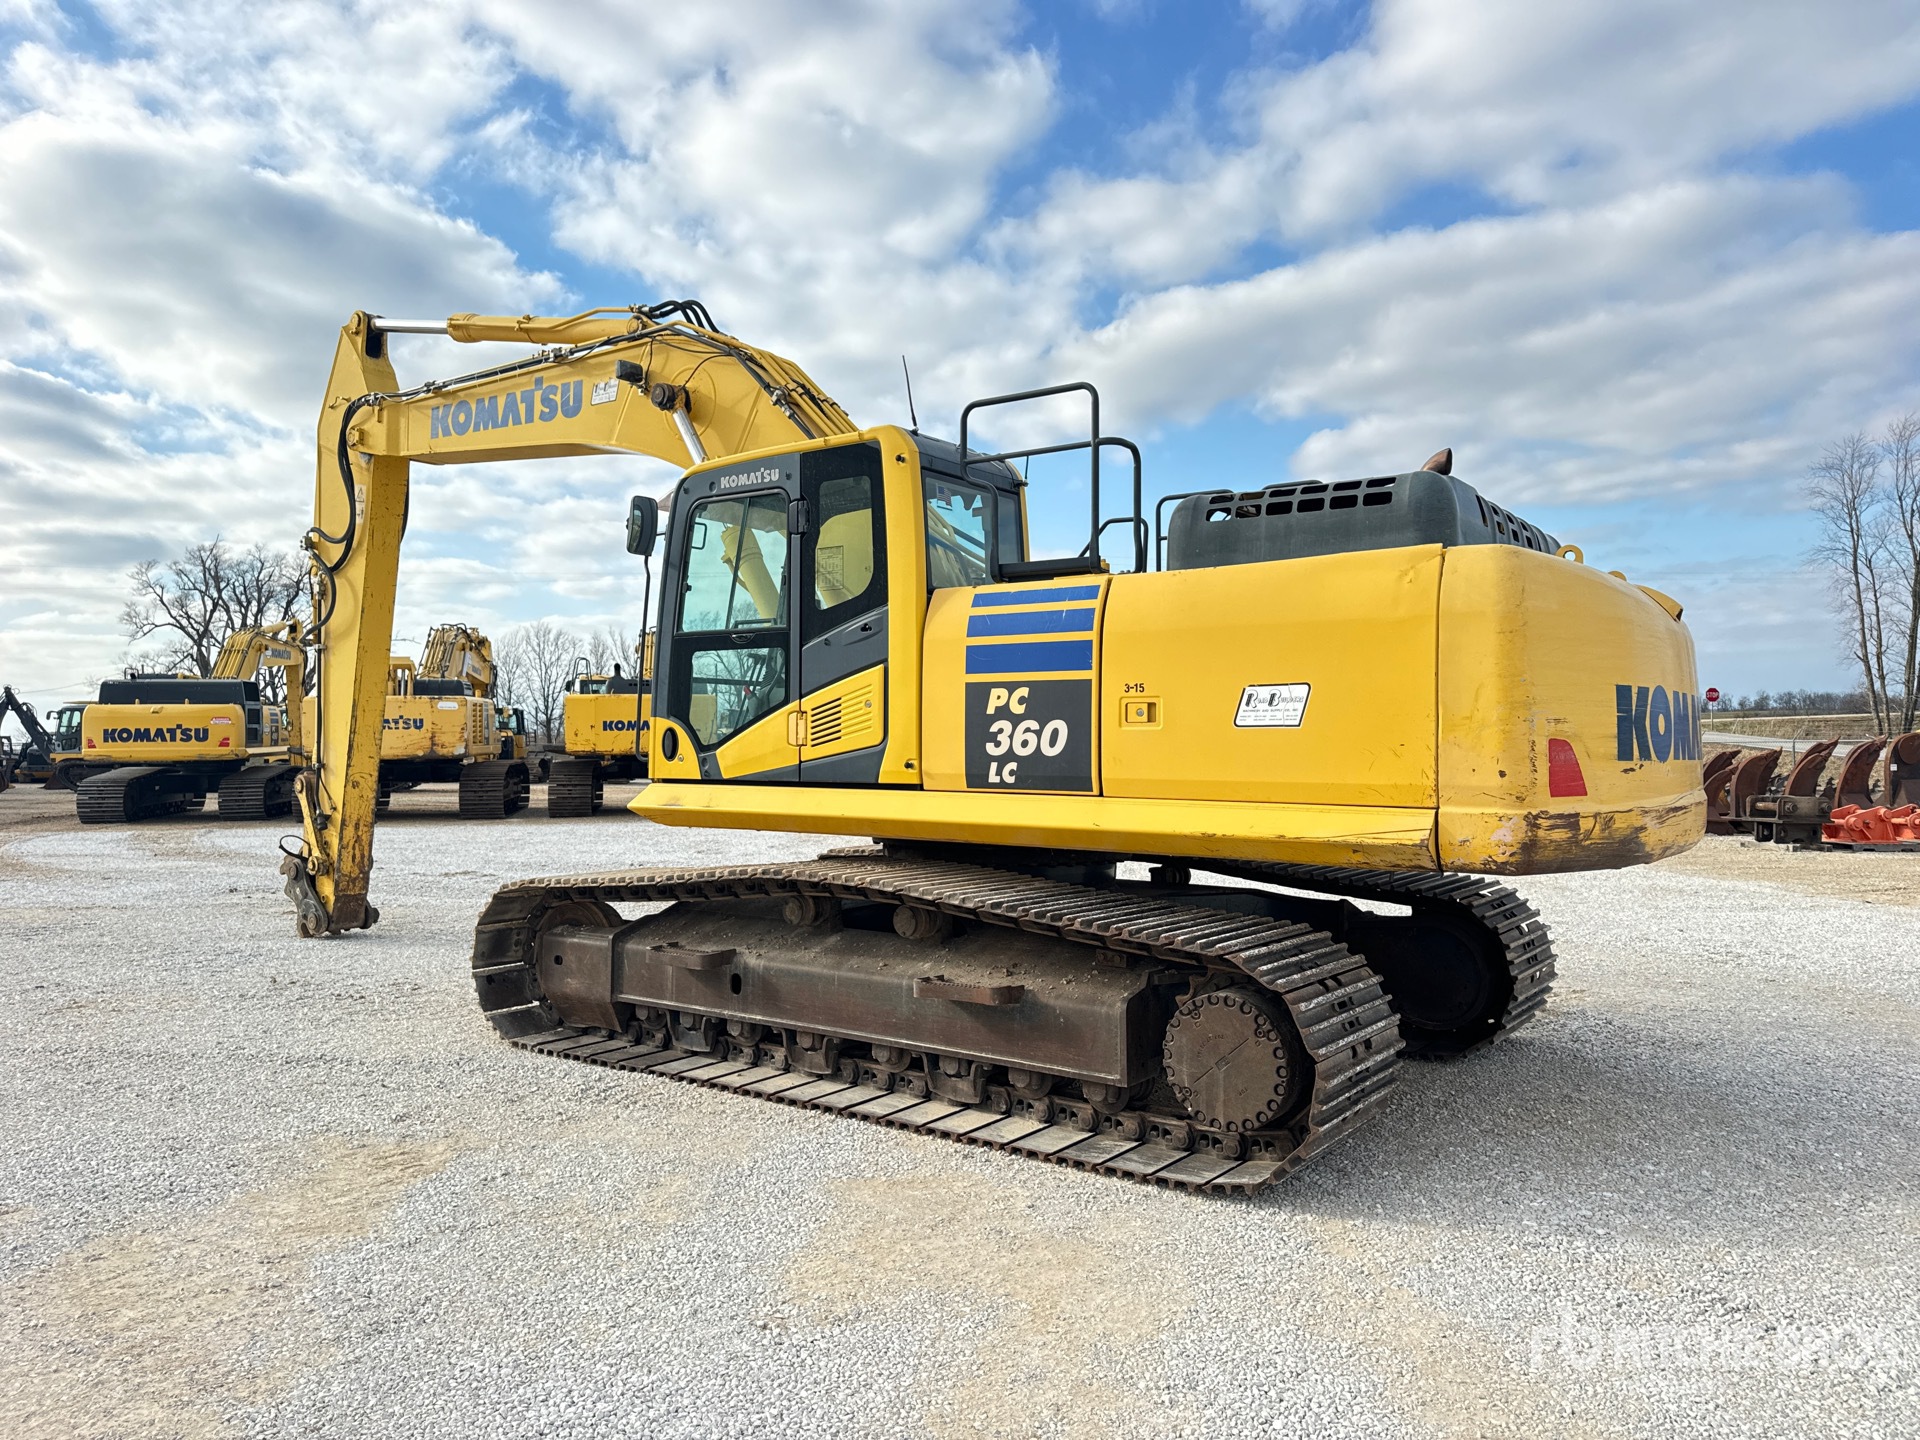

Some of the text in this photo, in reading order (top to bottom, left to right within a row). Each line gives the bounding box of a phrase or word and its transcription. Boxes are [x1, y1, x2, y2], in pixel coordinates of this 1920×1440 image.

[430, 375, 583, 440] KOMATSU
[720, 467, 779, 489] KOMATSU
[1124, 682, 1145, 693] 3-15
[1706, 691, 1719, 699] STOP
[986, 686, 1030, 715] PC
[382, 715, 424, 730] ATSU
[602, 720, 650, 731] KOMA
[103, 723, 209, 744] KOMATSU
[985, 719, 1069, 757] 360
[988, 761, 1018, 784] LC
